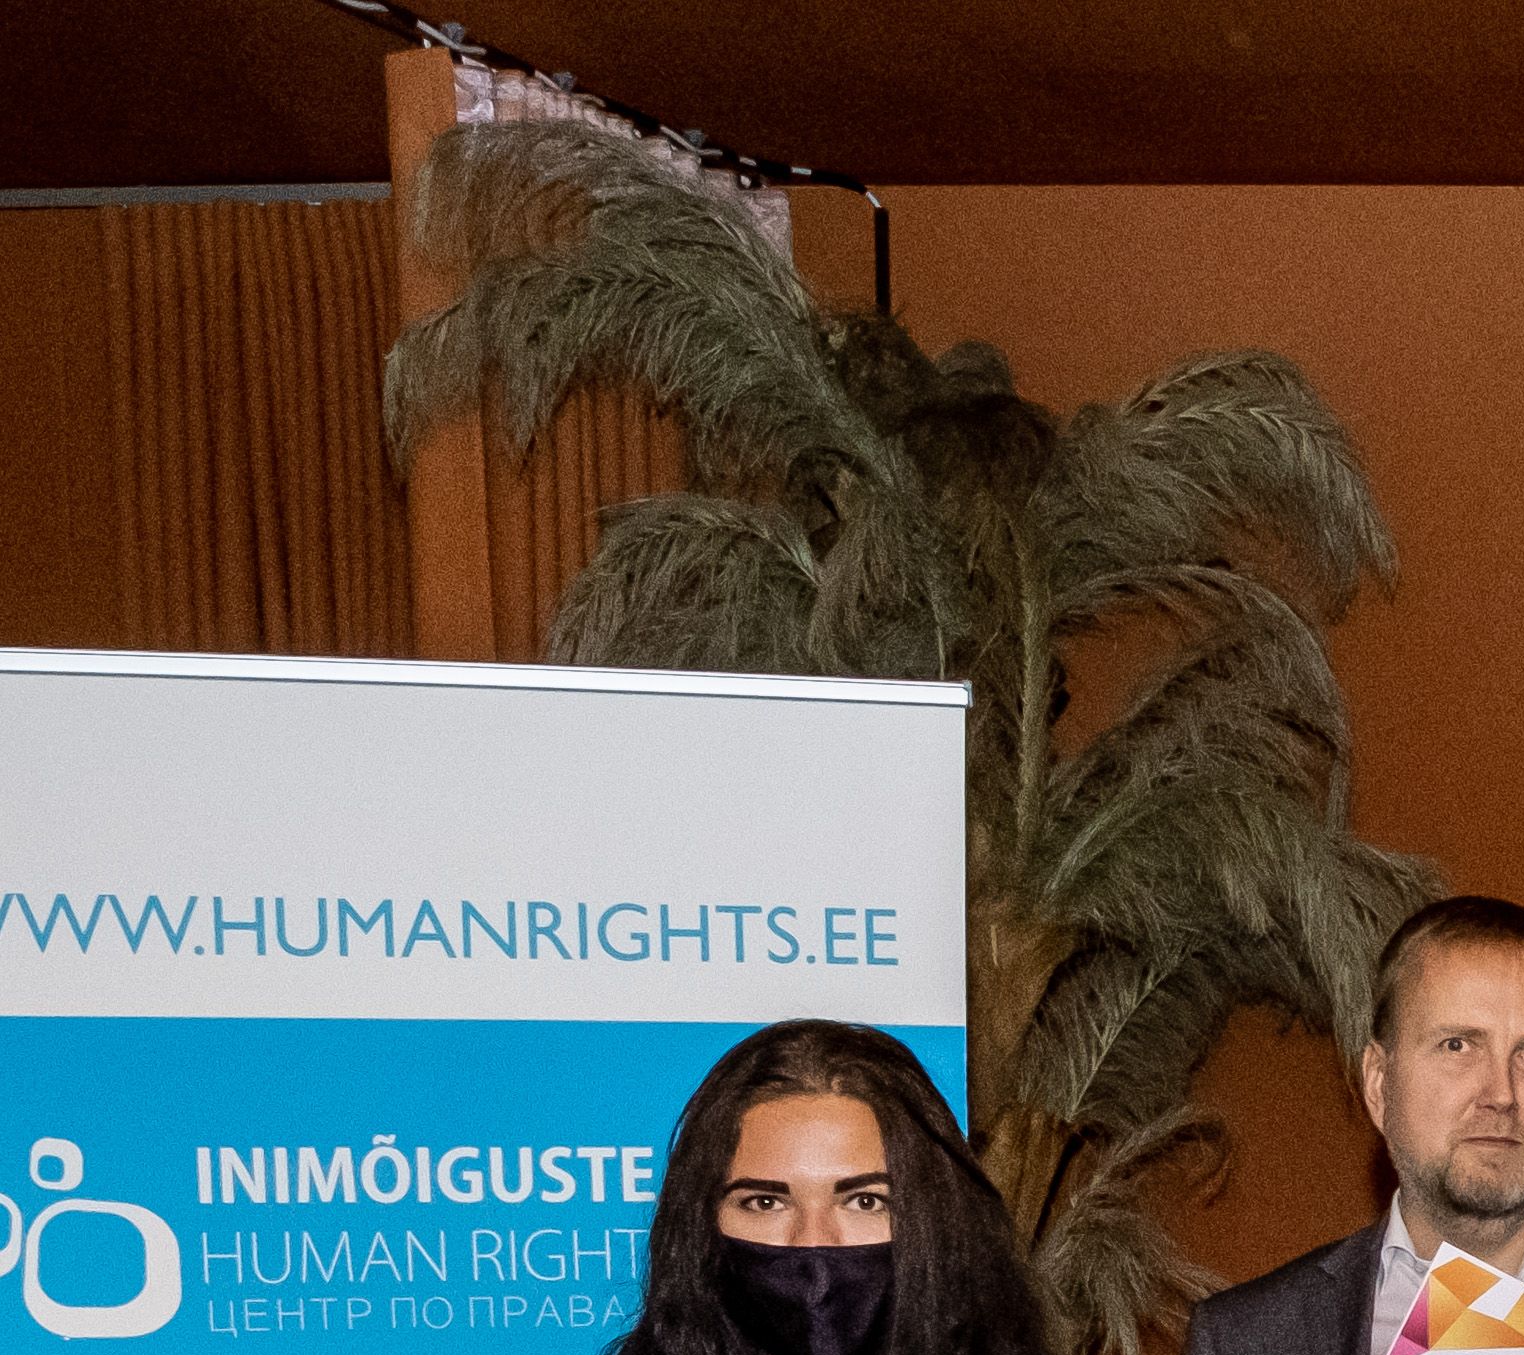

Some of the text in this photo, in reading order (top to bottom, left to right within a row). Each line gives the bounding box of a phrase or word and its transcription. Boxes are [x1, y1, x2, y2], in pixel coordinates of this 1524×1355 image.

[0, 892, 900, 966] WW.HUMANRIGHTS.EE
[196, 1134, 657, 1204] INIMÕIGUSTE
[201, 1229, 652, 1284] HUMAN RIGHT
[208, 1294, 627, 1337] ЦЕНТР ПО ПРАВА
